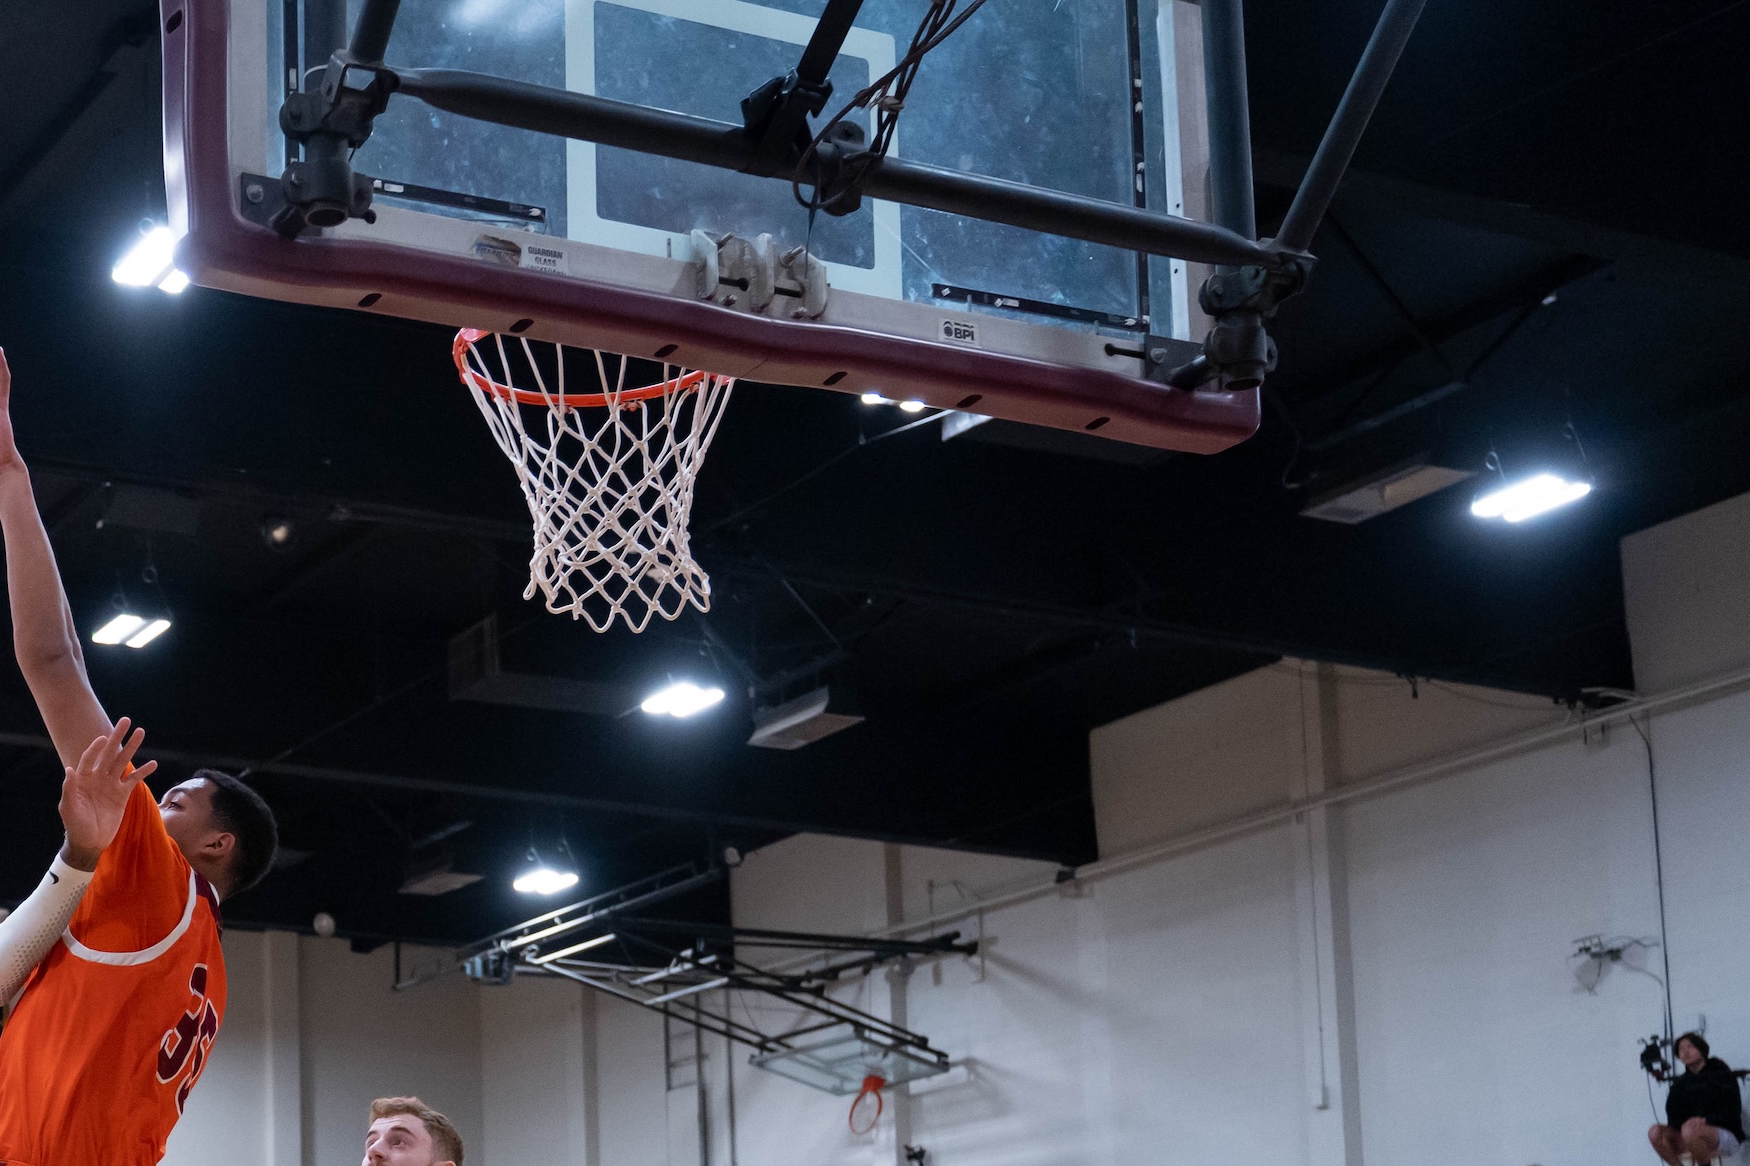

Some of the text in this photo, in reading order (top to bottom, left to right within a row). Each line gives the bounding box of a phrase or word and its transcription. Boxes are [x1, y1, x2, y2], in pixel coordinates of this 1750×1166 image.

[528, 246, 563, 259] GUARDIAN
[535, 256, 557, 267] GLASS
[954, 327, 975, 341] BPI
